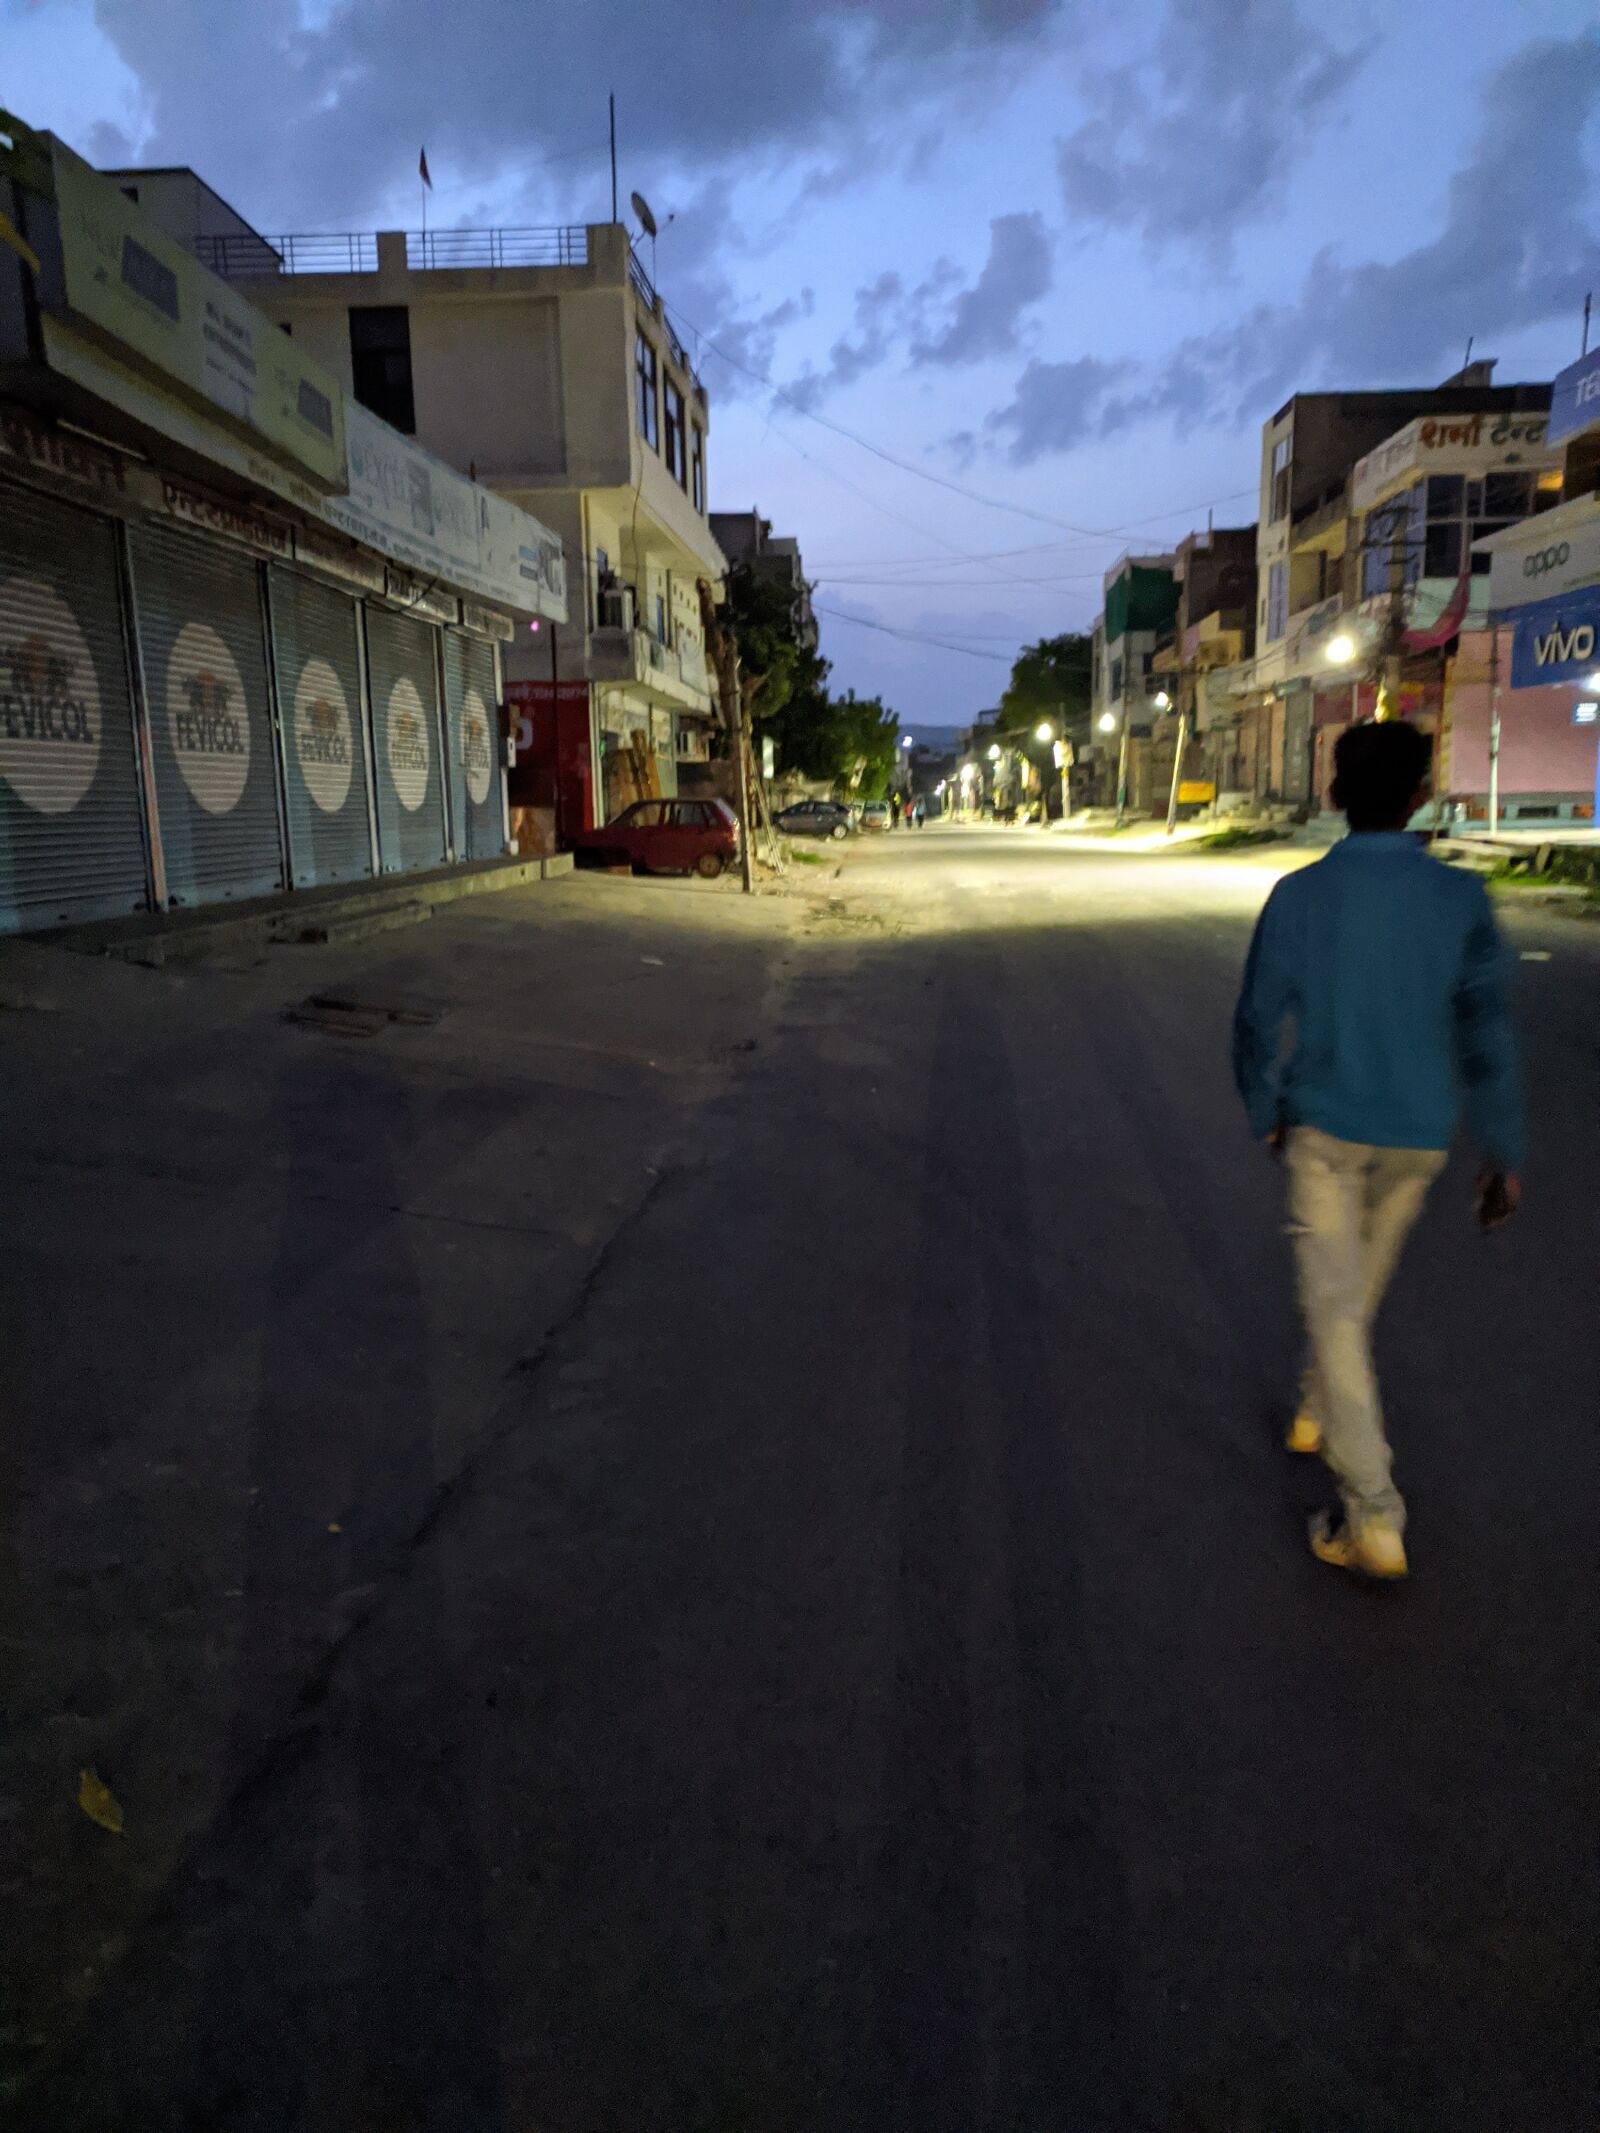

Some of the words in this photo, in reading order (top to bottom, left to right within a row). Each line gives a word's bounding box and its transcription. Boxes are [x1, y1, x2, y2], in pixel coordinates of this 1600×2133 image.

[1533, 619, 1595, 668] vivo
[0, 694, 94, 744] EVICOL
[175, 709, 245, 754] FEVICOL
